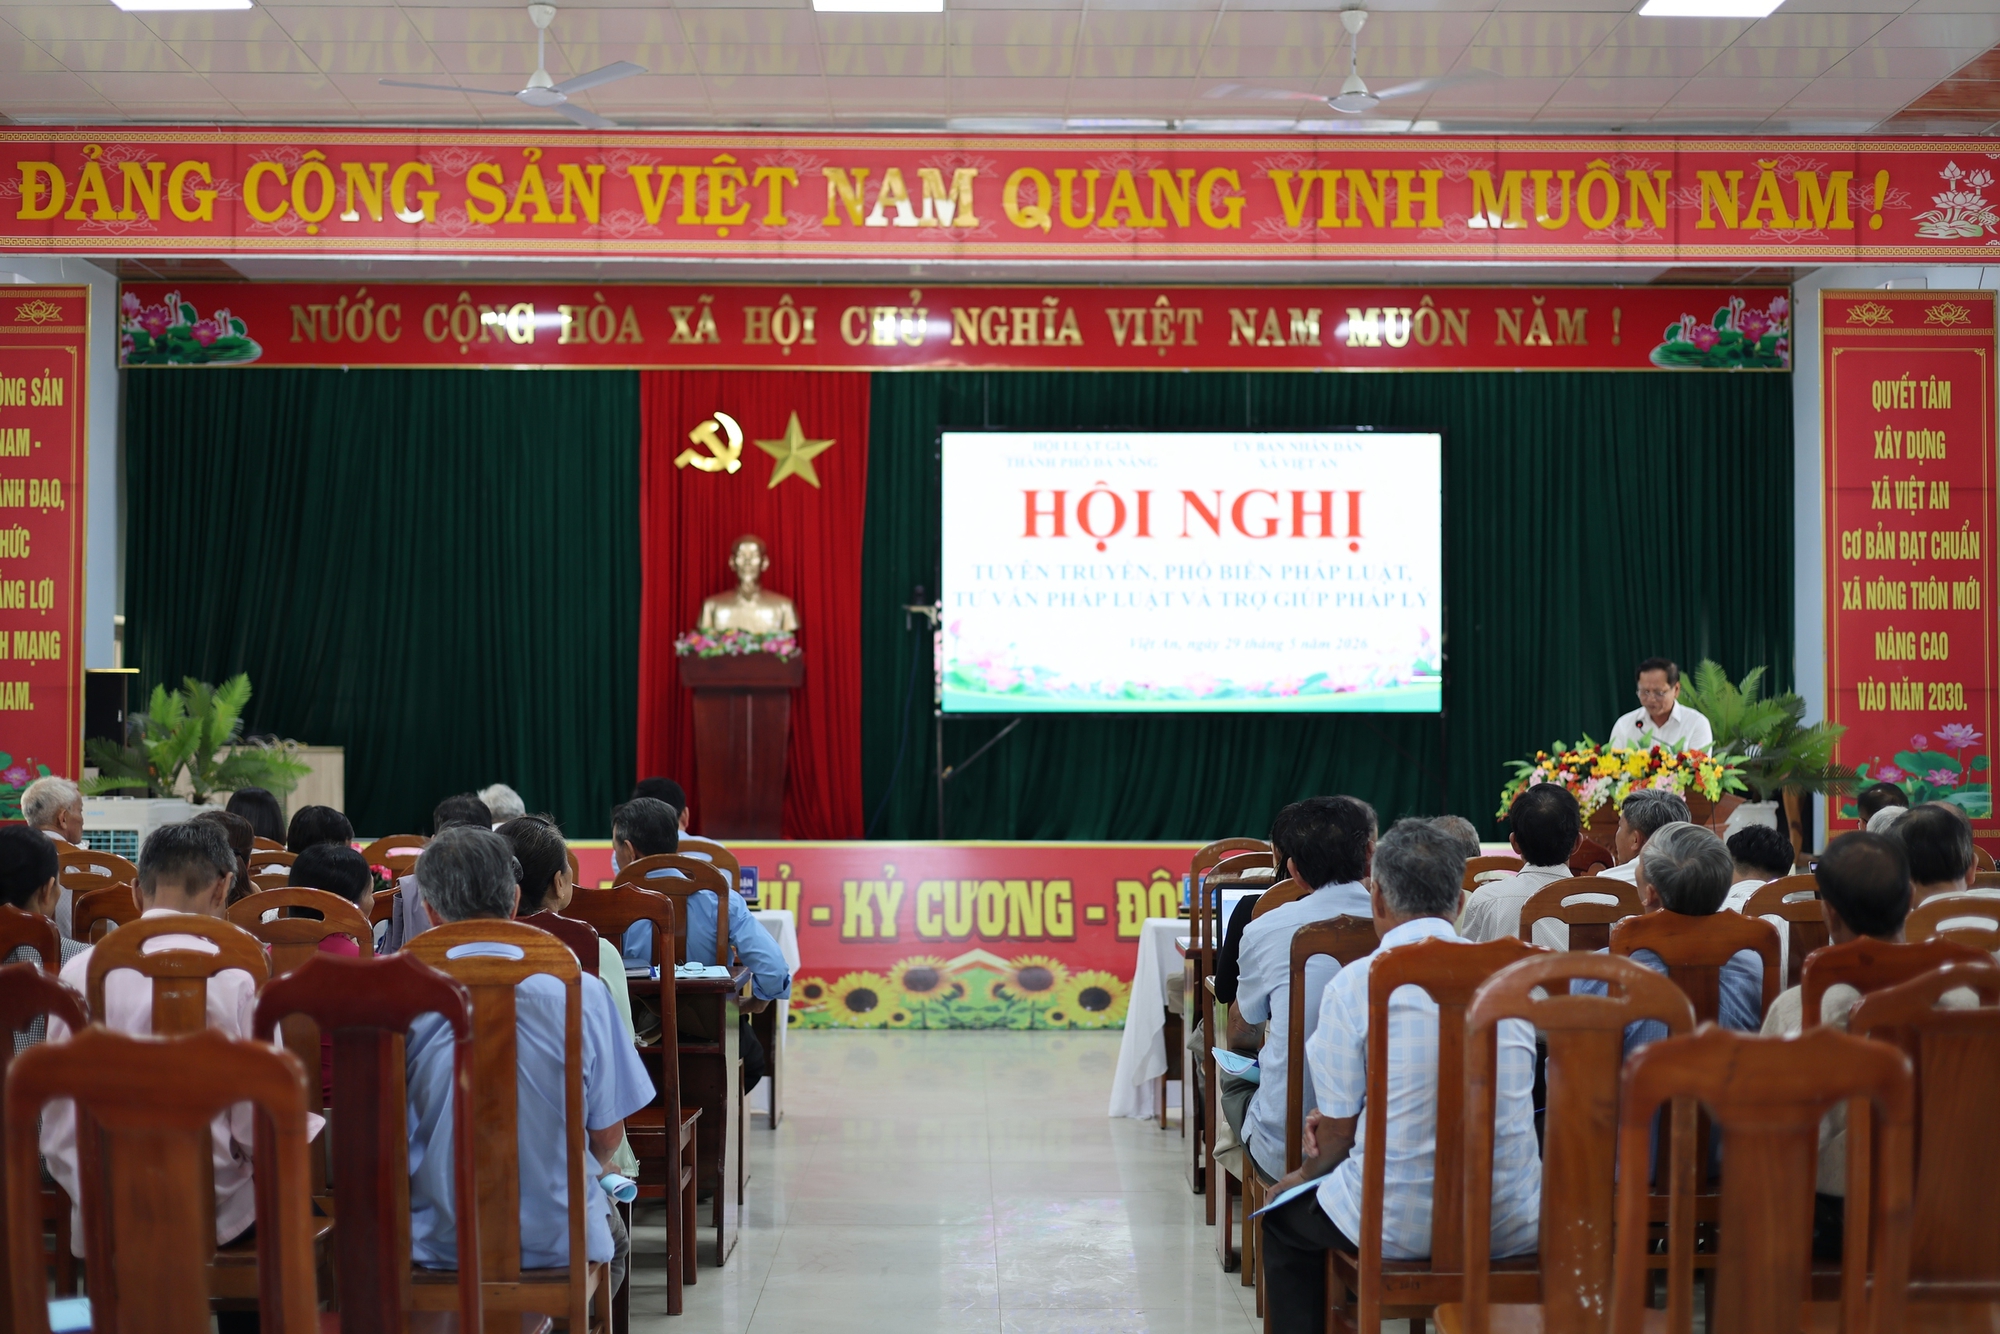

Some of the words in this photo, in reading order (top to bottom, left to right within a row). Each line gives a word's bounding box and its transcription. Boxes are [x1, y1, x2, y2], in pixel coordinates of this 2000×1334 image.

[17, 145, 218, 222] ĐẢNG
[243, 150, 440, 235] CỘNG
[465, 147, 606, 225] SẢN
[628, 153, 798, 237] VIỆT
[823, 167, 980, 229] NAM
[1003, 167, 1246, 235] QUANG
[1268, 169, 1444, 229] VINH
[1468, 160, 1671, 231] MUÔN
[1697, 160, 1854, 231] NĂM
[289, 287, 402, 344] NƯỚC
[422, 292, 536, 355] CỘNG
[558, 291, 643, 345] HÒA
[669, 295, 720, 345] XÃ
[743, 294, 818, 356] HỘI
[841, 290, 928, 347] CHỦ
[949, 297, 1083, 347] NGHĨA
[1105, 294, 1203, 357] VIỆT
[1228, 307, 1323, 348] NAM
[1346, 294, 1470, 348] MUÔN
[1494, 294, 1588, 348] NĂM
[31, 368, 63, 407] SẢN
[1871, 371, 1917, 412] QUYẾT
[1920, 374, 1951, 409] TÂM
[1106, 440, 1132, 453] GIA
[1256, 441, 1287, 453] BAN
[1317, 457, 1338, 470] AN
[1874, 425, 1903, 459] XÂY
[1906, 427, 1946, 466] DỰNG
[29, 478, 65, 514] ĐẠO,
[1871, 475, 1892, 510] XÃ
[1894, 475, 1926, 516] VIỆT
[1929, 481, 1950, 510] AN
[1020, 480, 1154, 552] HỘI
[1178, 488, 1364, 553] NGHỊ
[1842, 527, 1862, 561] CƠ
[1866, 521, 1896, 560] BẢN
[1899, 530, 1927, 566] ĐẠT
[1931, 519, 1980, 560] CHUẨN
[972, 561, 1050, 582] TUYÊN
[1280, 561, 1341, 582] PHÁP
[1347, 564, 1413, 586] LUẬT,
[30, 577, 55, 615] LỢI
[953, 589, 987, 609] TƯ
[1047, 588, 1108, 609] PHÁP
[1112, 590, 1176, 613] LUẬT
[1181, 588, 1214, 609] VÀ
[1219, 590, 1268, 613] TRỢ
[1273, 588, 1330, 609] GIÚP
[1335, 588, 1396, 609] PHÁP
[1401, 588, 1431, 609] LÝ
[1842, 575, 1863, 611] XÃ
[1866, 575, 1907, 611] NÔNG
[1910, 575, 1949, 611] THÔN
[1952, 575, 1980, 611] MỚI
[13, 630, 61, 666] MẠNG
[1187, 638, 1220, 654] ngày
[1225, 637, 1242, 651] 29
[1244, 637, 1285, 654] tháng
[1300, 638, 1331, 651] năm
[1336, 637, 1369, 651] 2026
[1875, 625, 1916, 661] NÂNG
[1920, 631, 1949, 661] CAO
[1857, 675, 1887, 711] VÀO
[1890, 676, 1924, 711] NĂM
[1928, 682, 1968, 711] 2030.
[842, 864, 904, 937] KỶ
[917, 878, 1073, 937] CƯƠNG
